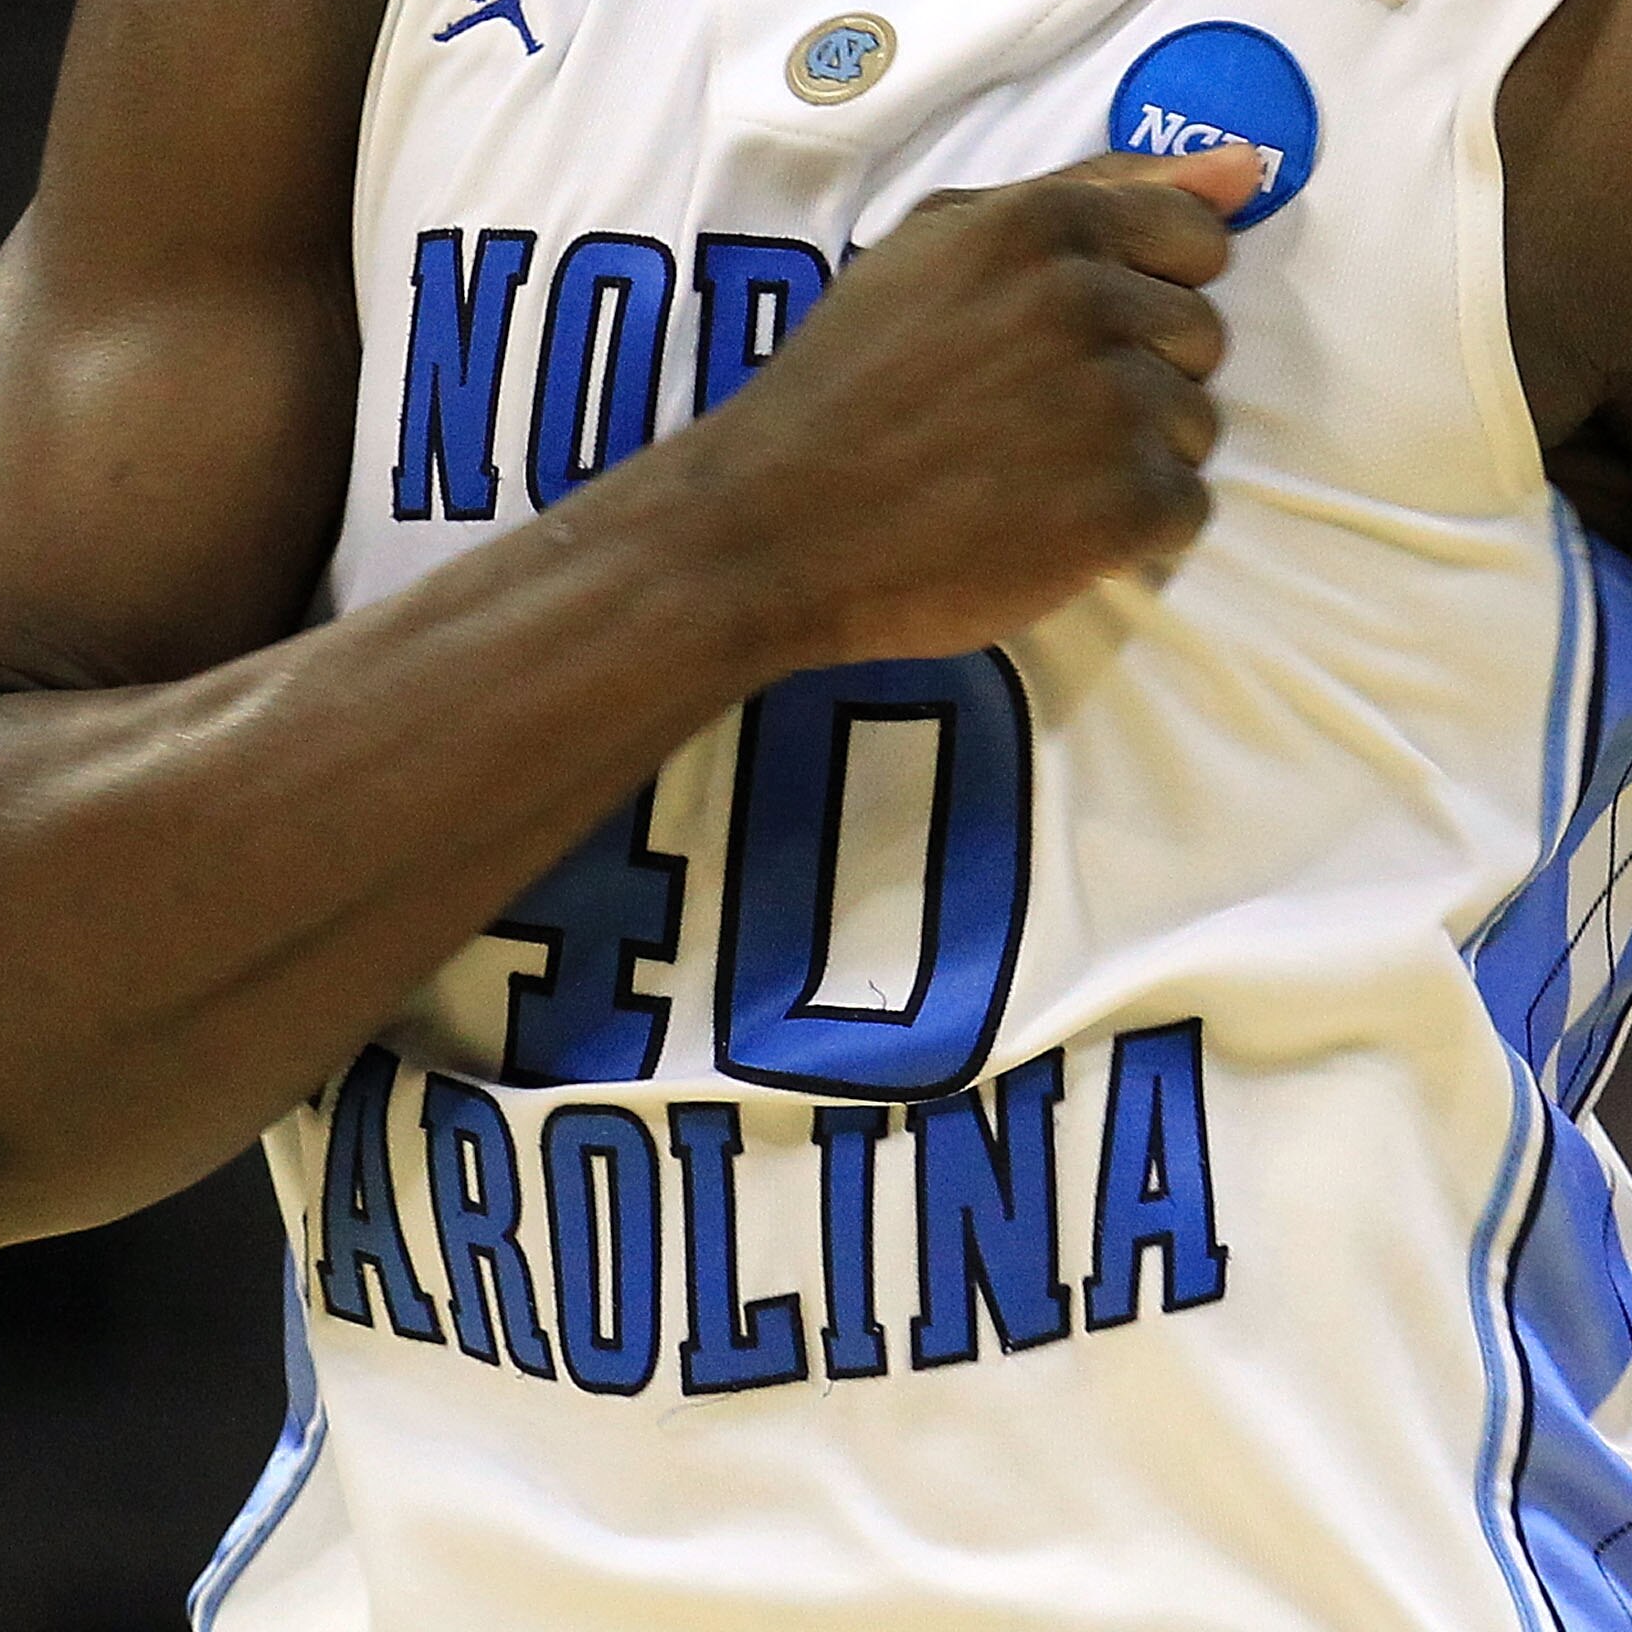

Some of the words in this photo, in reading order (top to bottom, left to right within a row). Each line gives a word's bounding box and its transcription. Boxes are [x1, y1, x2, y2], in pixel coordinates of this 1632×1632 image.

[1128, 103, 1285, 194] NCA
[392, 229, 860, 522] NOR
[304, 1016, 1228, 1396] AROLINA
